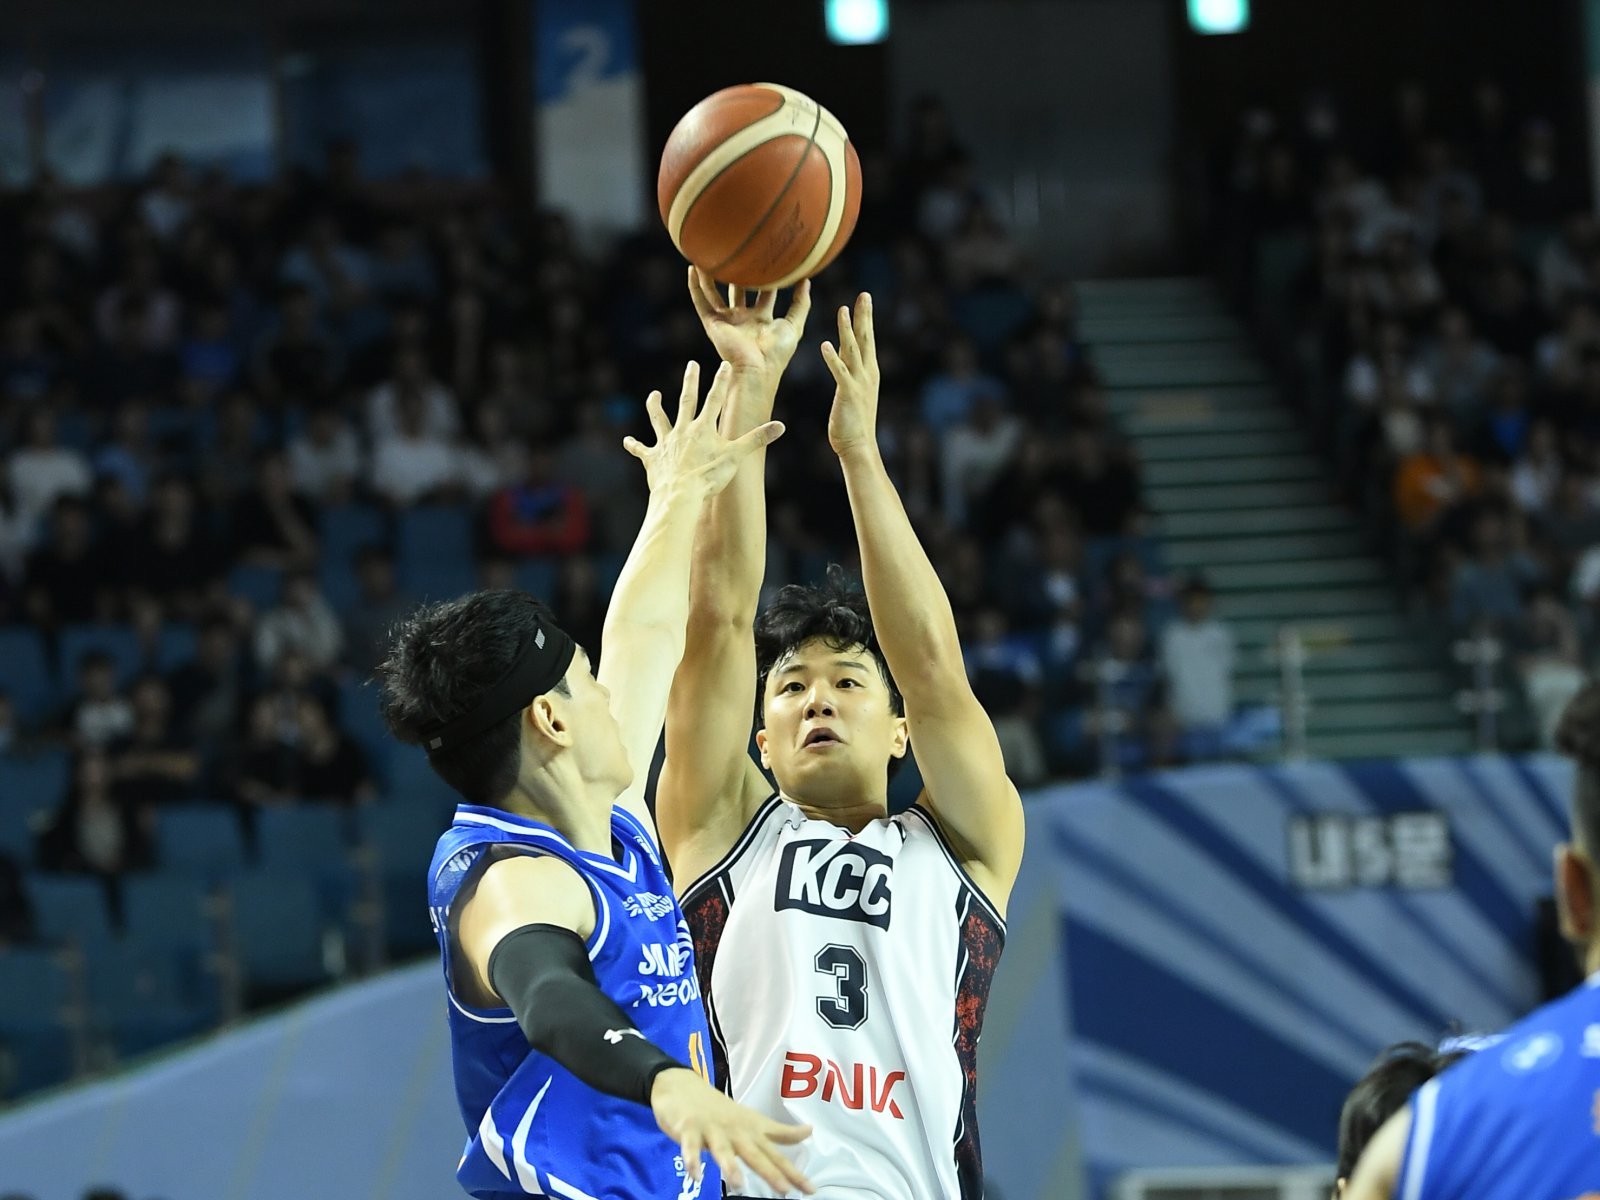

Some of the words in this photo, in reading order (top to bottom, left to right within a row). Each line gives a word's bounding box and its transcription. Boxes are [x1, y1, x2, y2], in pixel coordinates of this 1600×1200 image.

[787, 844, 893, 917] KCC
[814, 942, 870, 1030] 3
[780, 1050, 905, 1120] BNK
